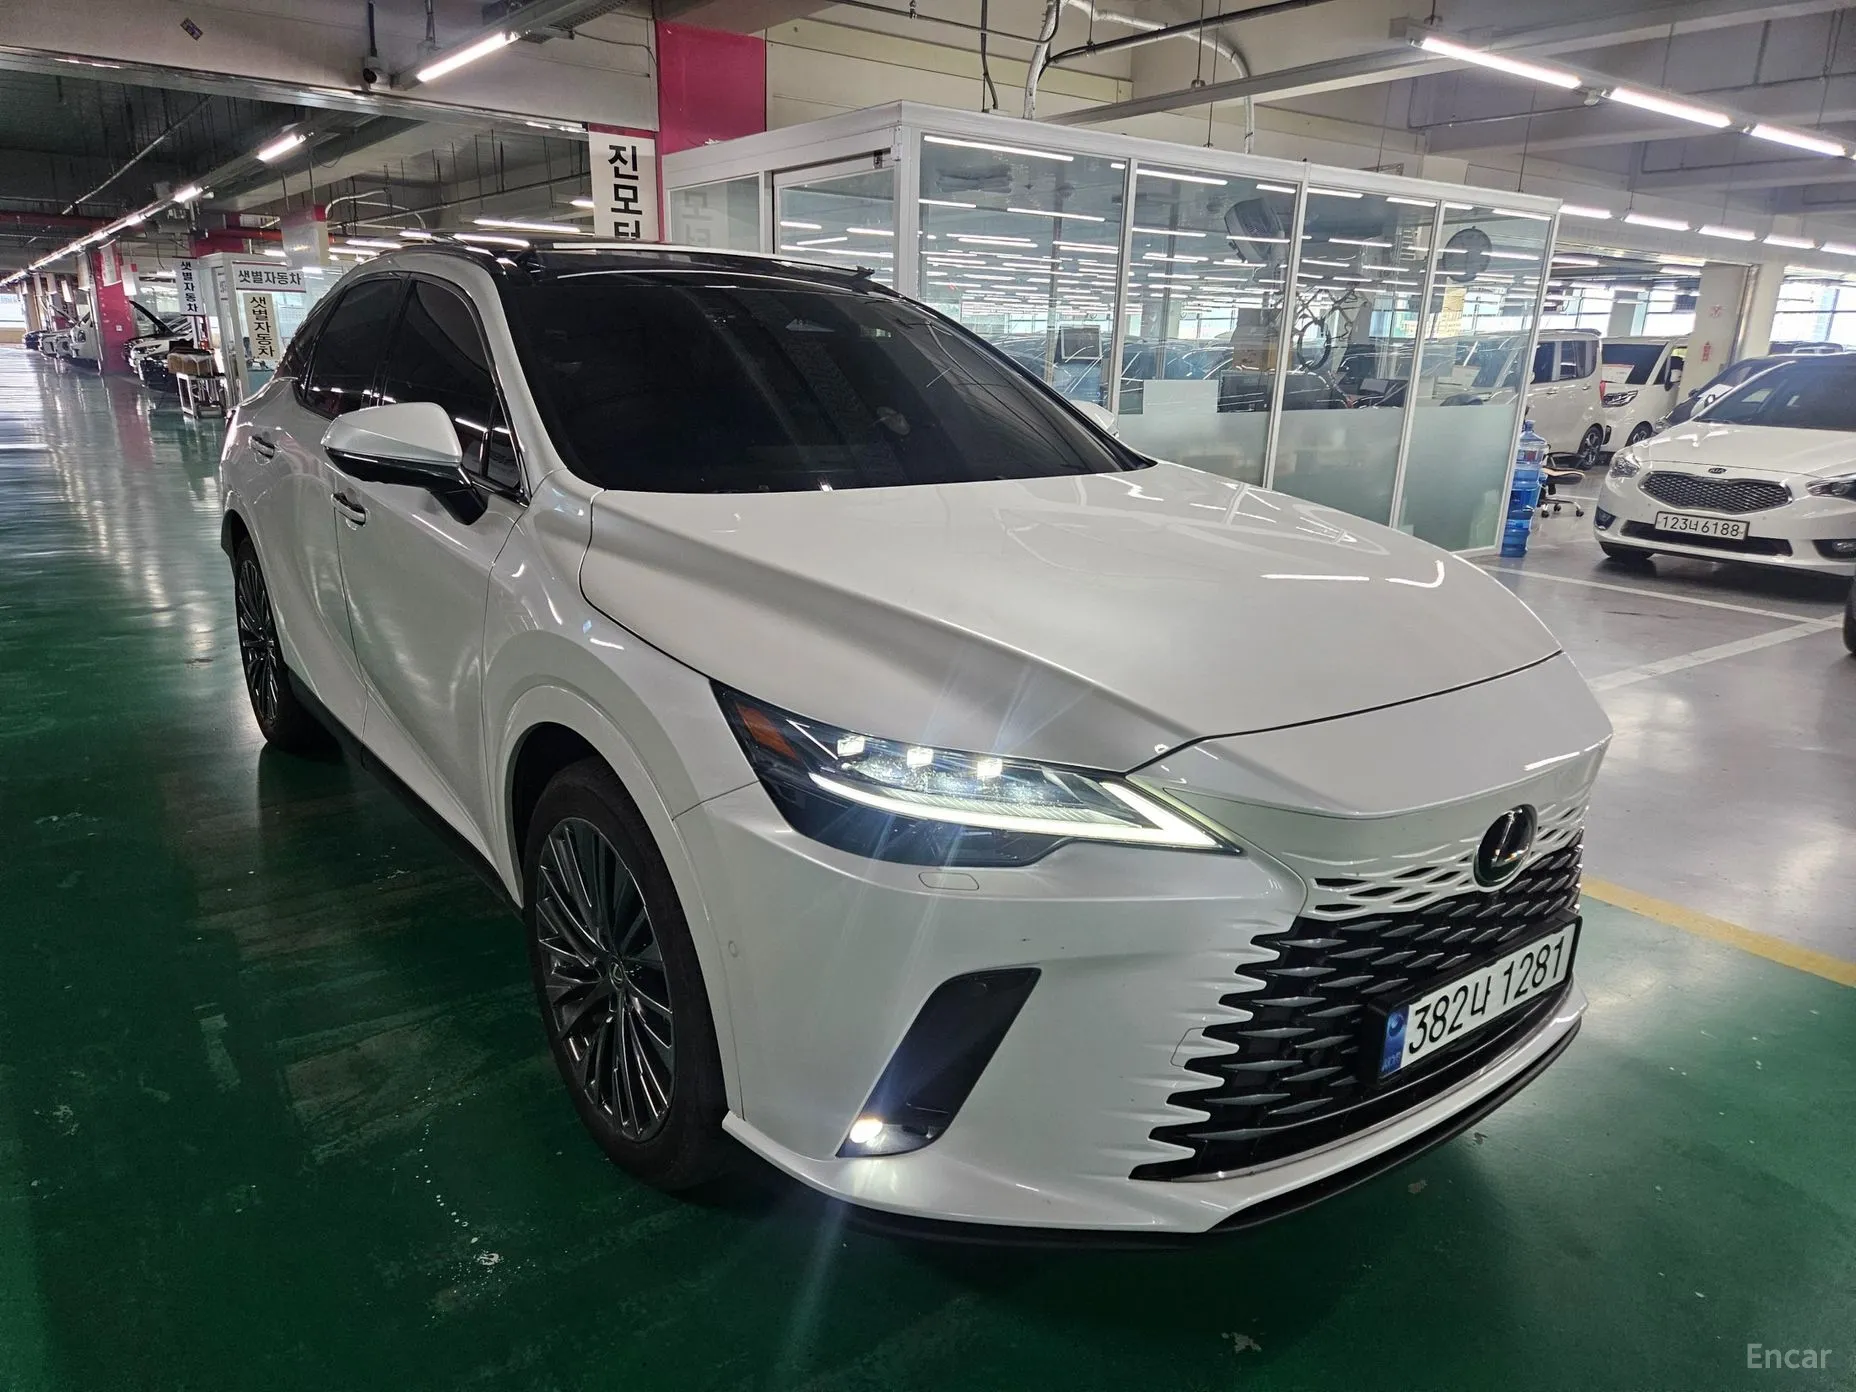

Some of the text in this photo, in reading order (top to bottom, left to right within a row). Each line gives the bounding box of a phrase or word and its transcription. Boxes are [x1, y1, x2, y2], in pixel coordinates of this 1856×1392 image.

[180, 261, 198, 312] 샛별자동차
[238, 270, 301, 286] 샛별자동차
[250, 296, 275, 358] 샛별자동차
